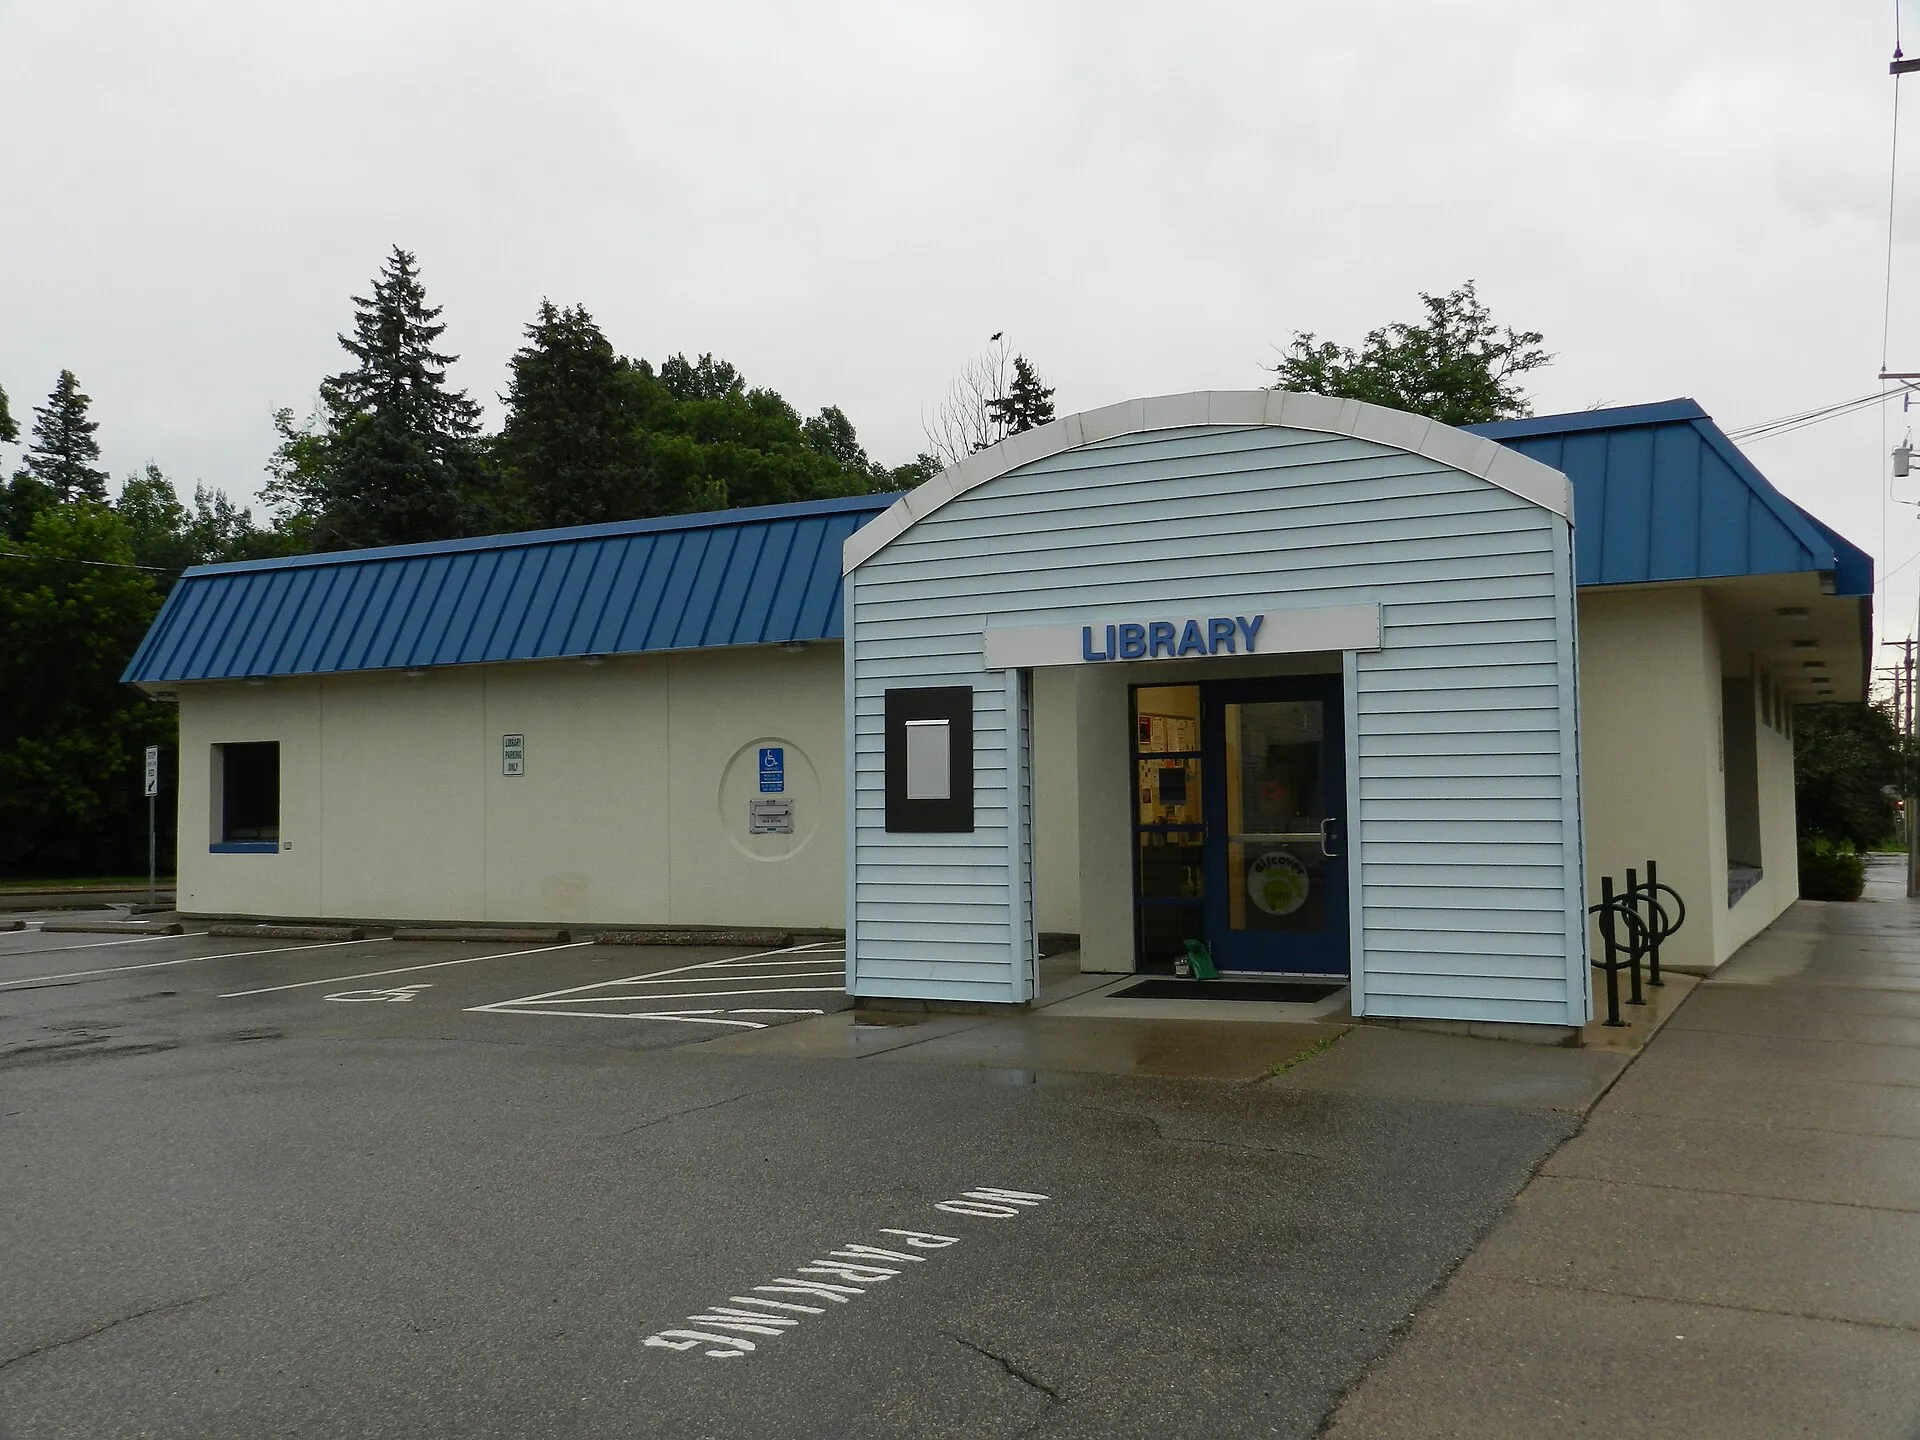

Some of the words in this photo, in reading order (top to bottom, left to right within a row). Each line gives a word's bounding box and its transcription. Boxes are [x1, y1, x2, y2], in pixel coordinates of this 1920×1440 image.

[1082, 614, 1265, 661] LIBRARY
[505, 738, 521, 747] LIBRARY
[505, 750, 522, 759] PARKING
[508, 762, 518, 771] ONLY
[1255, 856, 1305, 875] discover
[933, 1186, 1052, 1218] NO
[642, 1227, 961, 1359] PARKING
